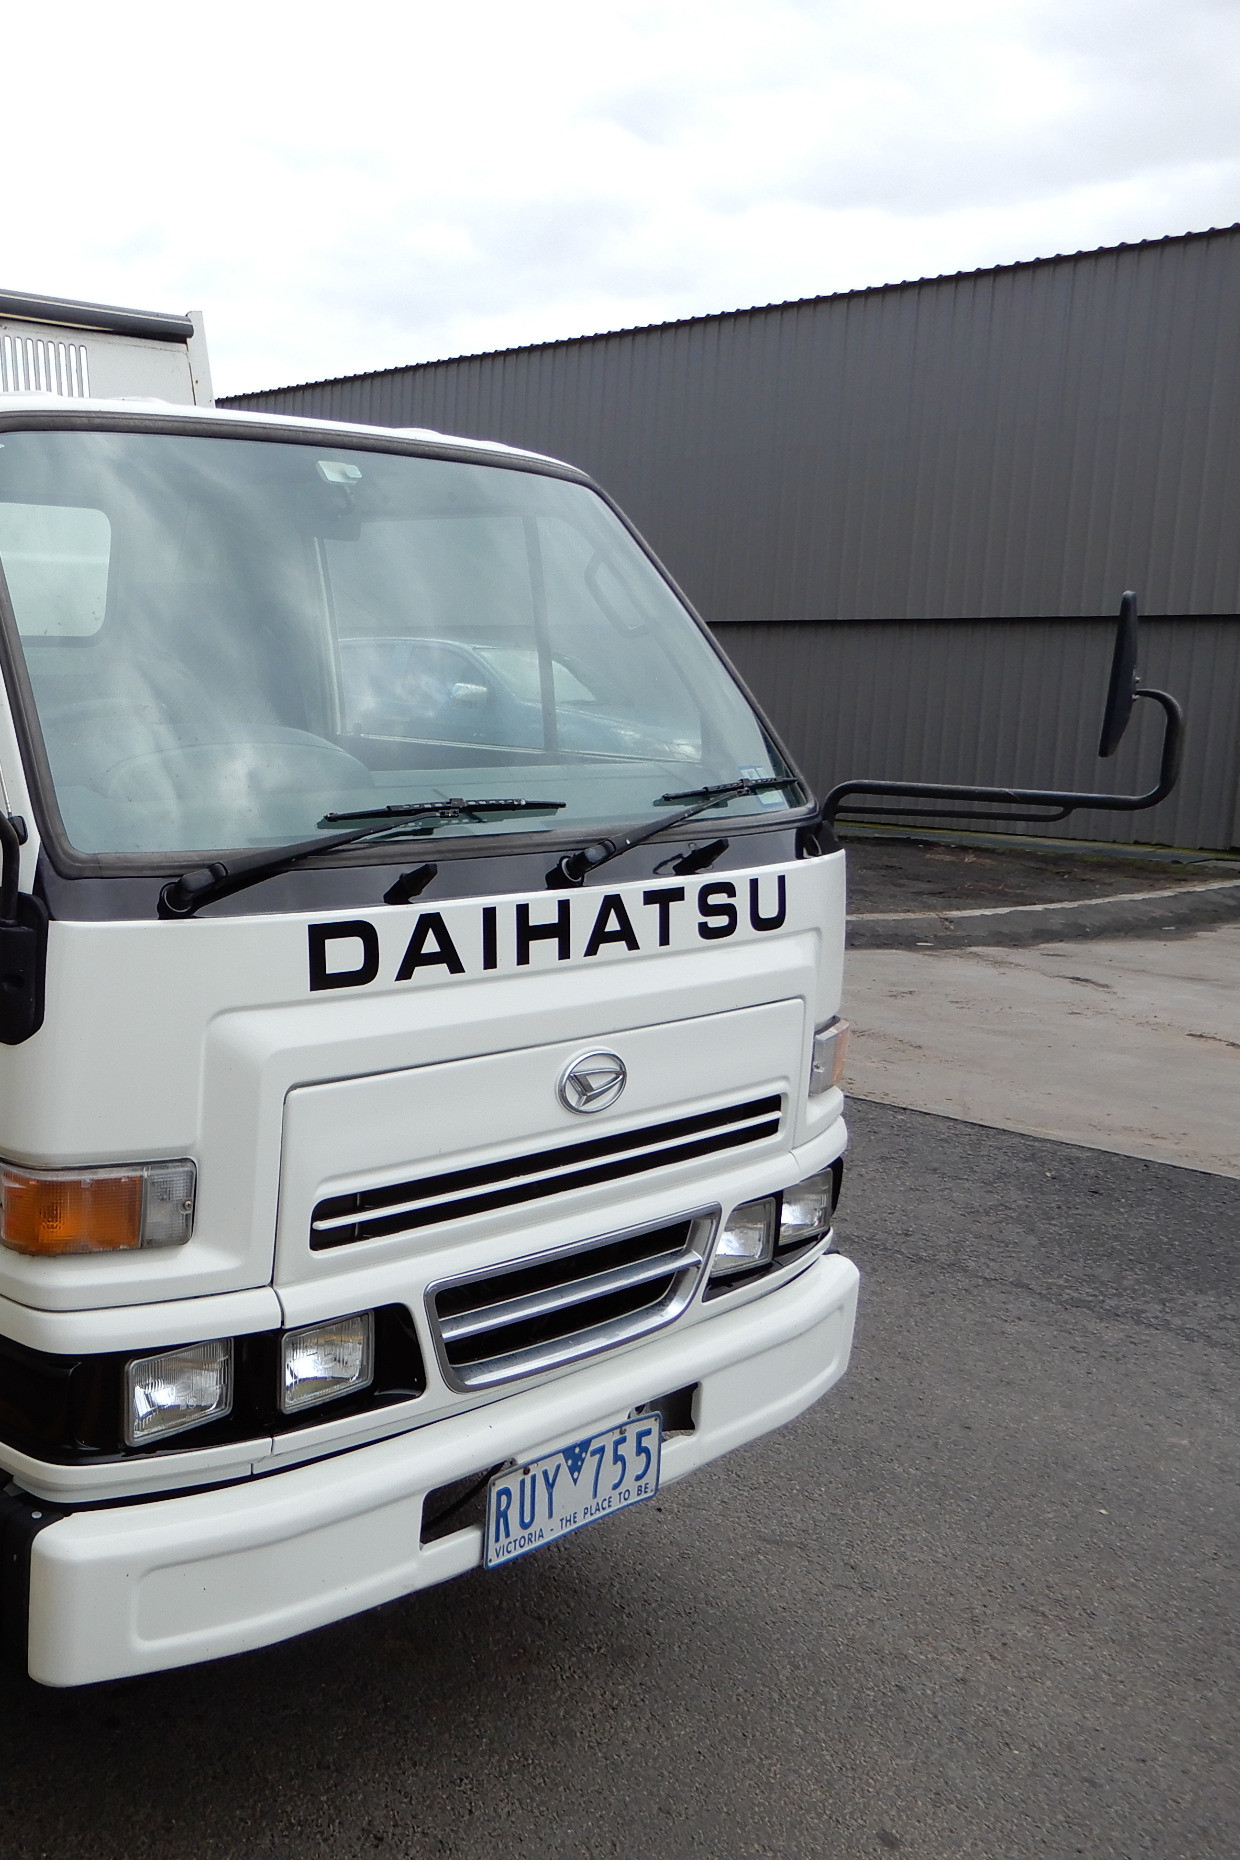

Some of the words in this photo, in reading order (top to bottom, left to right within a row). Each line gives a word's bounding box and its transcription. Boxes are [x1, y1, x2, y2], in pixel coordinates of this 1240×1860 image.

[307, 875, 786, 992] DAIHATSU
[494, 1463, 561, 1543] RUY
[589, 1428, 652, 1499] 755
[495, 1528, 544, 1559] VICTORIA
[559, 1511, 578, 1530] THE
[583, 1495, 613, 1519] PLACE
[618, 1489, 631, 1504] TO
[636, 1482, 650, 1497] BE
